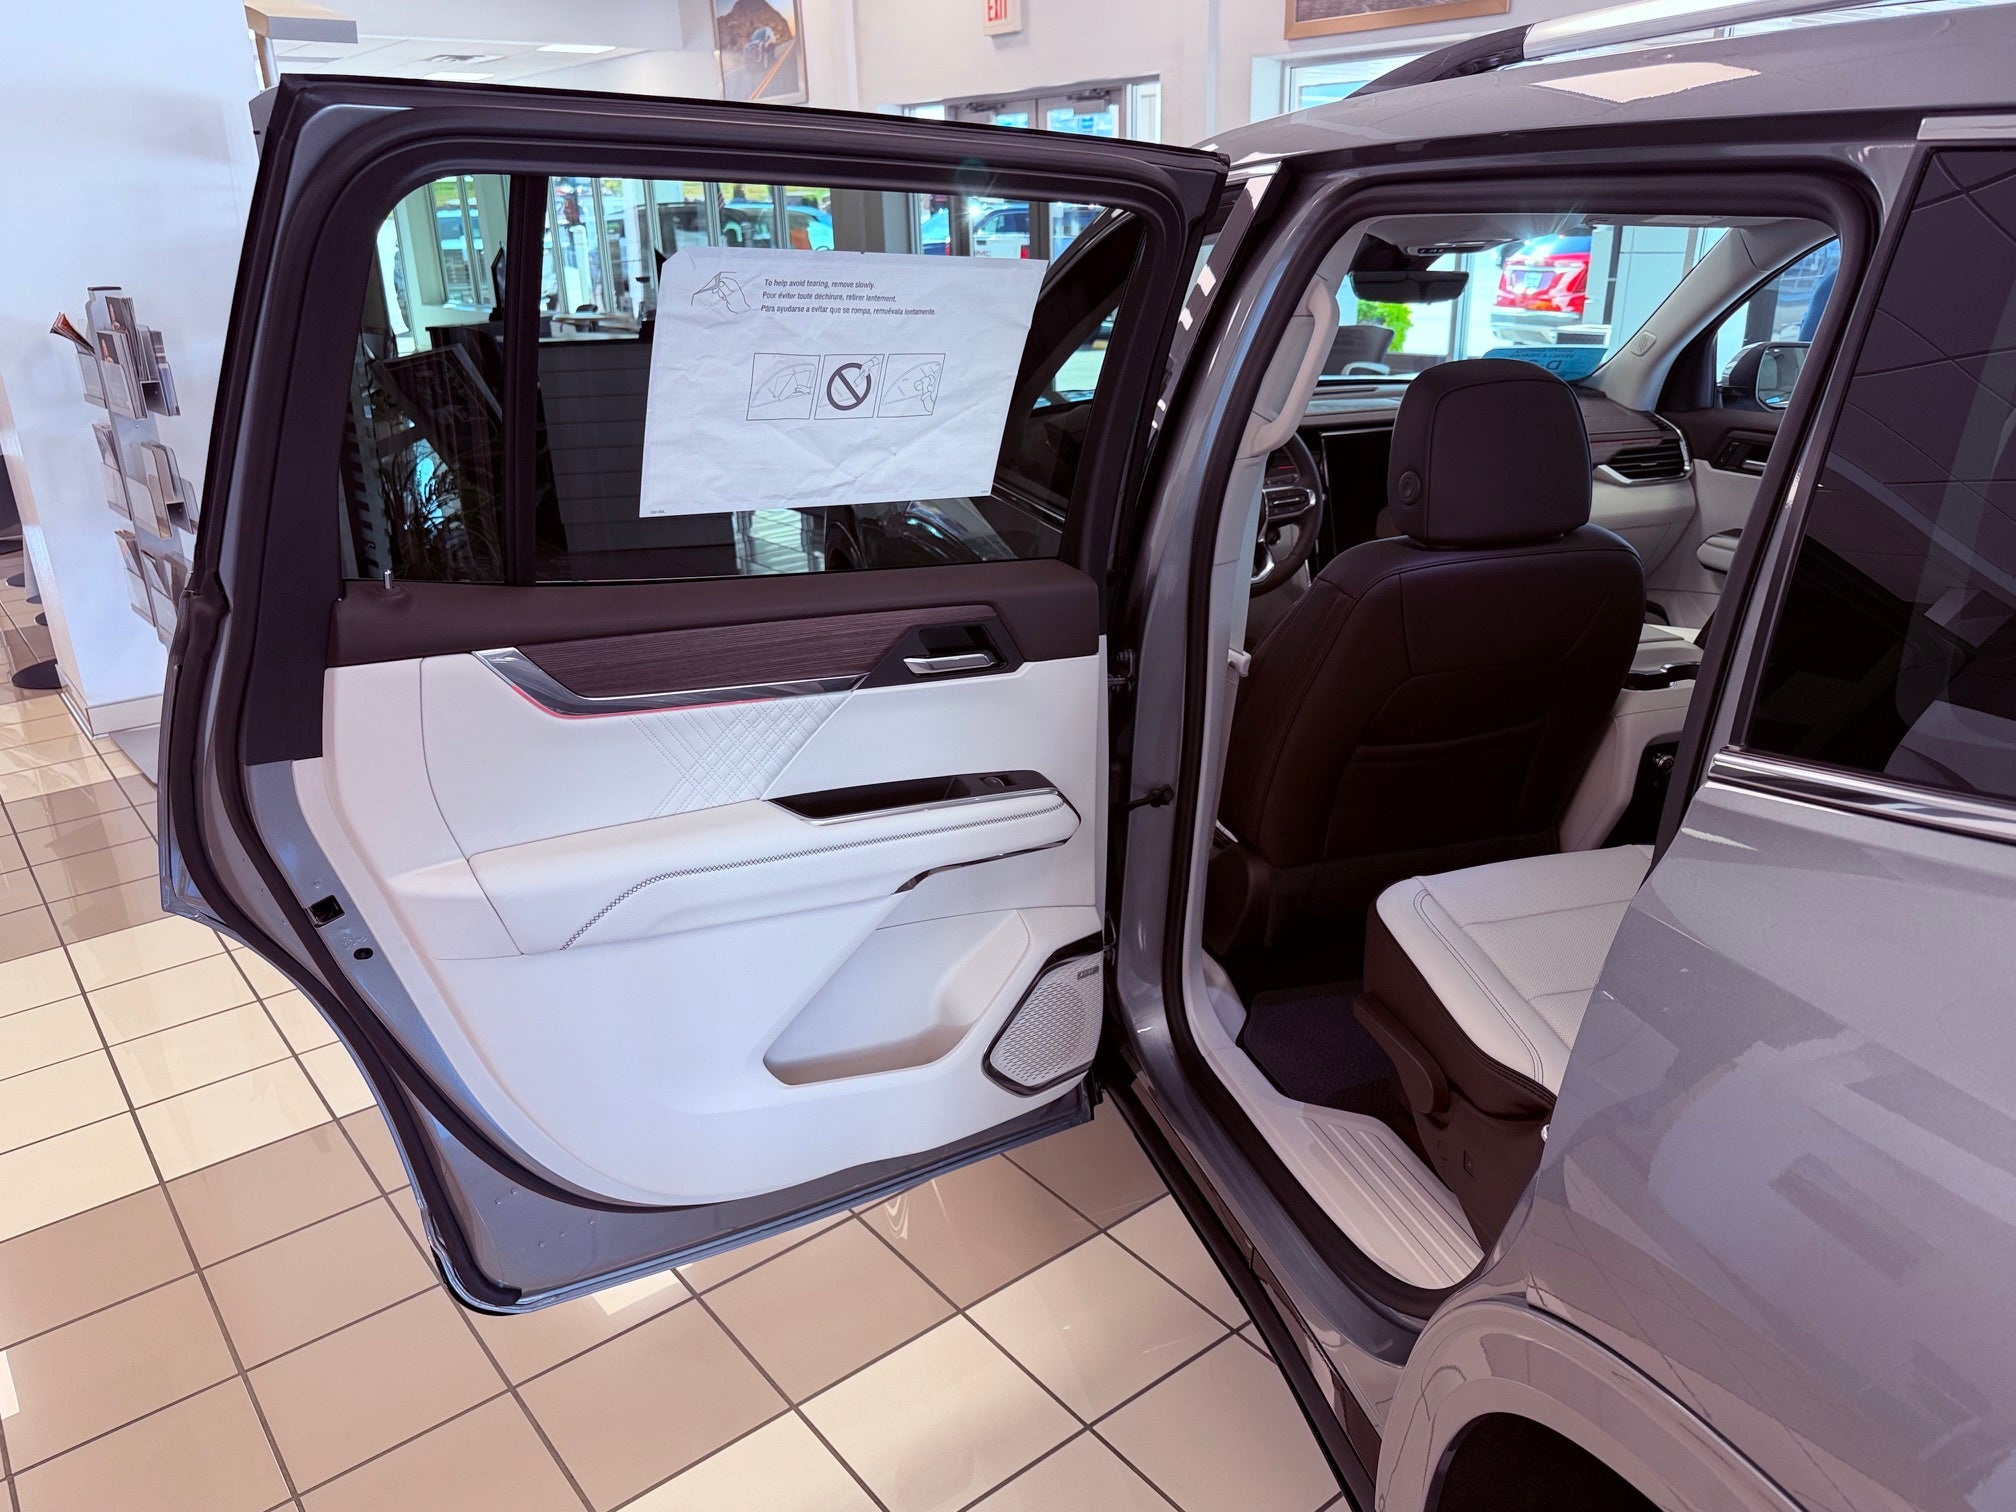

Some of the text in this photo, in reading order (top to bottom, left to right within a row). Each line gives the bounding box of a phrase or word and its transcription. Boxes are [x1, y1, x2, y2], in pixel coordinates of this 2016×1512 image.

[764, 279, 773, 287] To
[773, 279, 788, 288] help
[806, 280, 830, 289] tearing,
[854, 281, 876, 290] slowly.
[762, 291, 777, 299] Pour
[778, 292, 797, 300] éviter
[797, 292, 813, 300] toute
[814, 292, 845, 301] déchirure,
[866, 294, 897, 302] lentement.
[760, 304, 775, 312] Para
[776, 305, 805, 314] ayudarse
[850, 307, 872, 316] rompa,
[873, 307, 904, 315] remuévala
